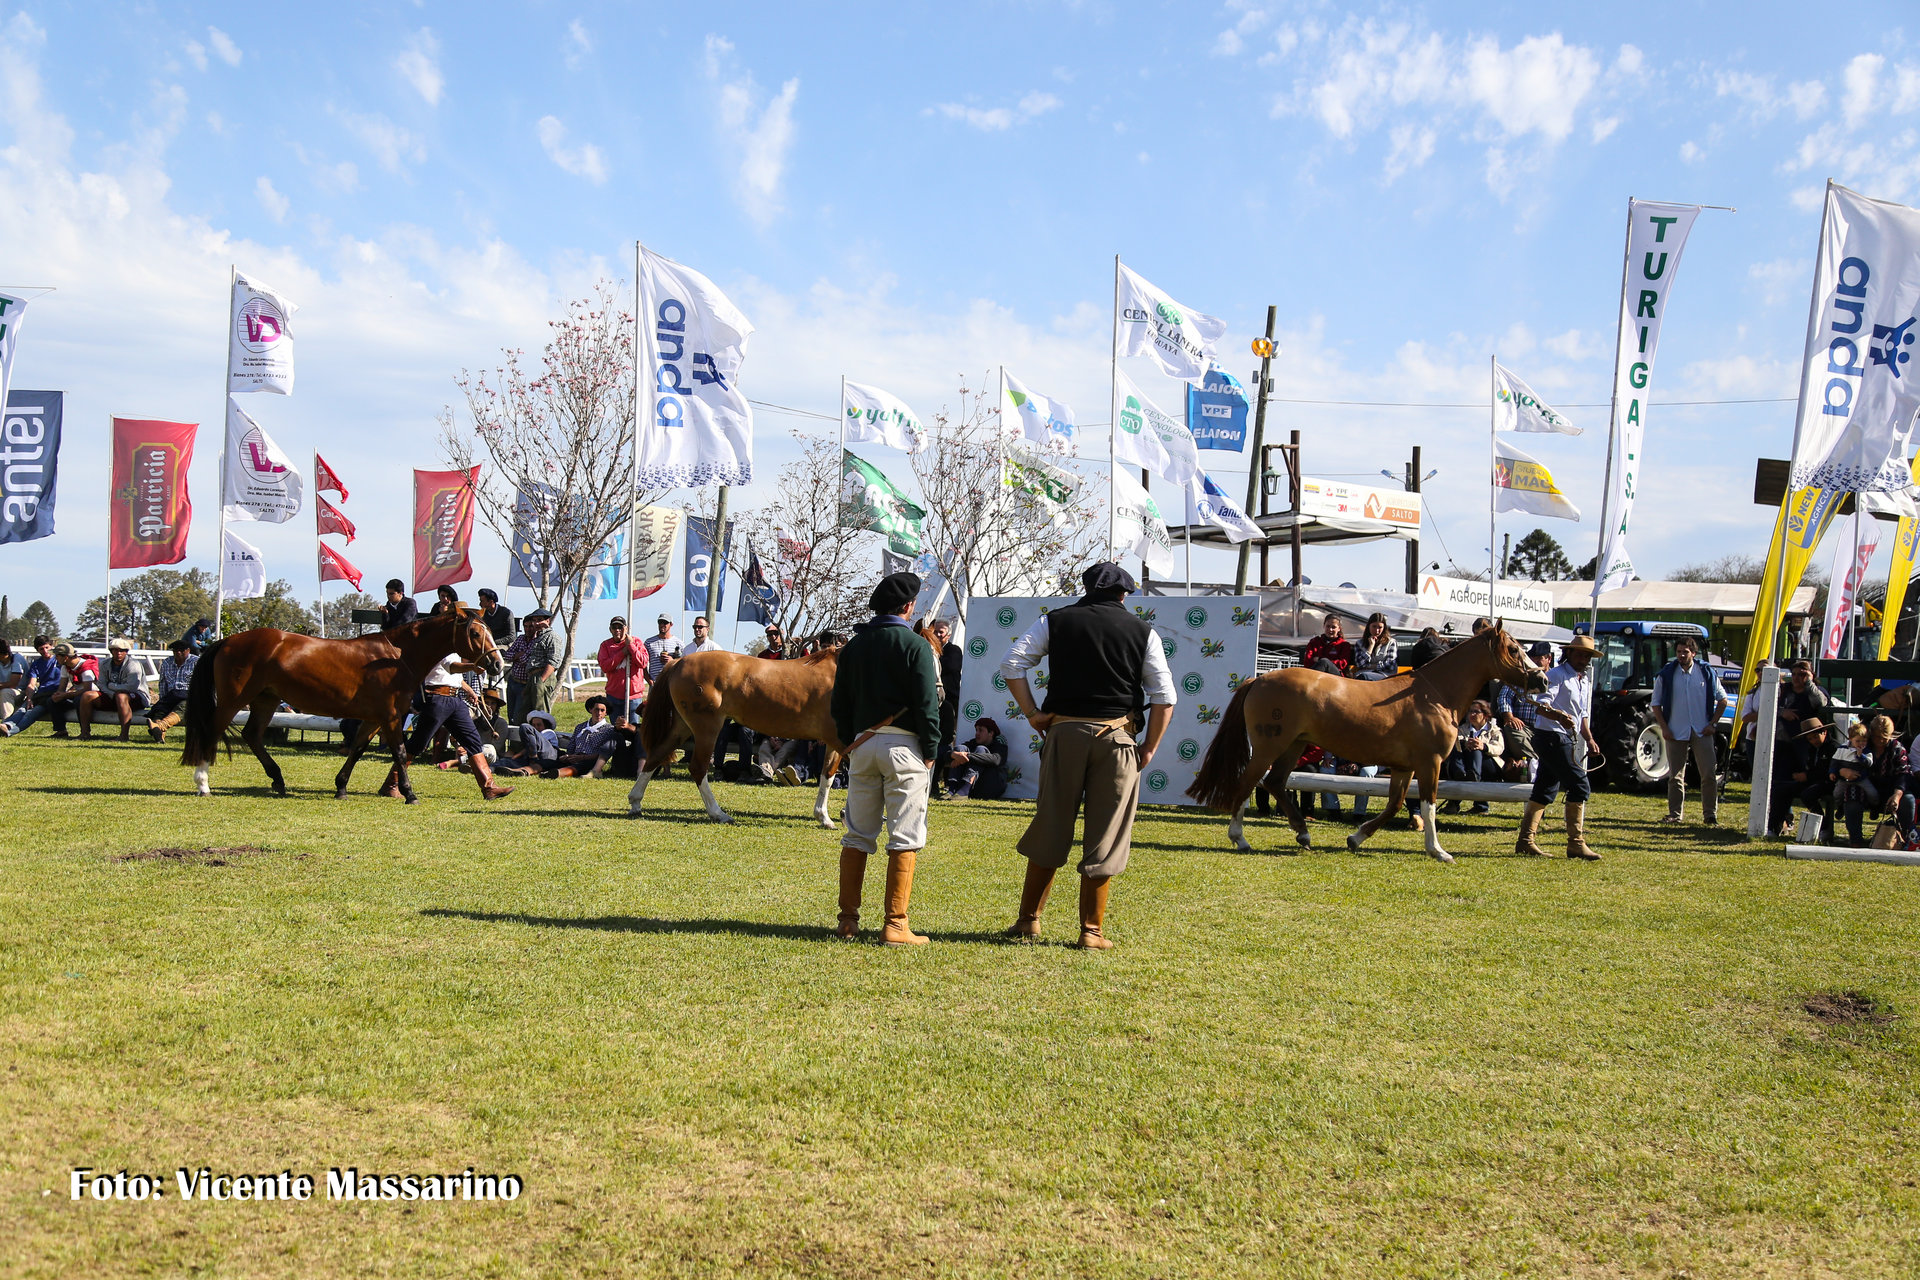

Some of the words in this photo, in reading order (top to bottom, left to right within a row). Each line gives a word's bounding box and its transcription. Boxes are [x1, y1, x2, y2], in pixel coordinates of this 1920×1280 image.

[1168, 329, 1204, 361] LANERA
[1627, 215, 1678, 461] TURIGAL
[1822, 256, 1871, 418] anda
[656, 298, 692, 428] anda
[1120, 415, 1140, 430] CTO
[1204, 406, 1229, 415] YPF
[1192, 427, 1241, 441] ELAION
[0, 405, 45, 523] antel
[139, 450, 172, 537] Patricia
[1337, 503, 1348, 513] 3M
[1797, 488, 1815, 516] NEW
[434, 493, 461, 565] Patricia
[1391, 508, 1413, 520] SALTO
[1522, 598, 1550, 613] SALTO
